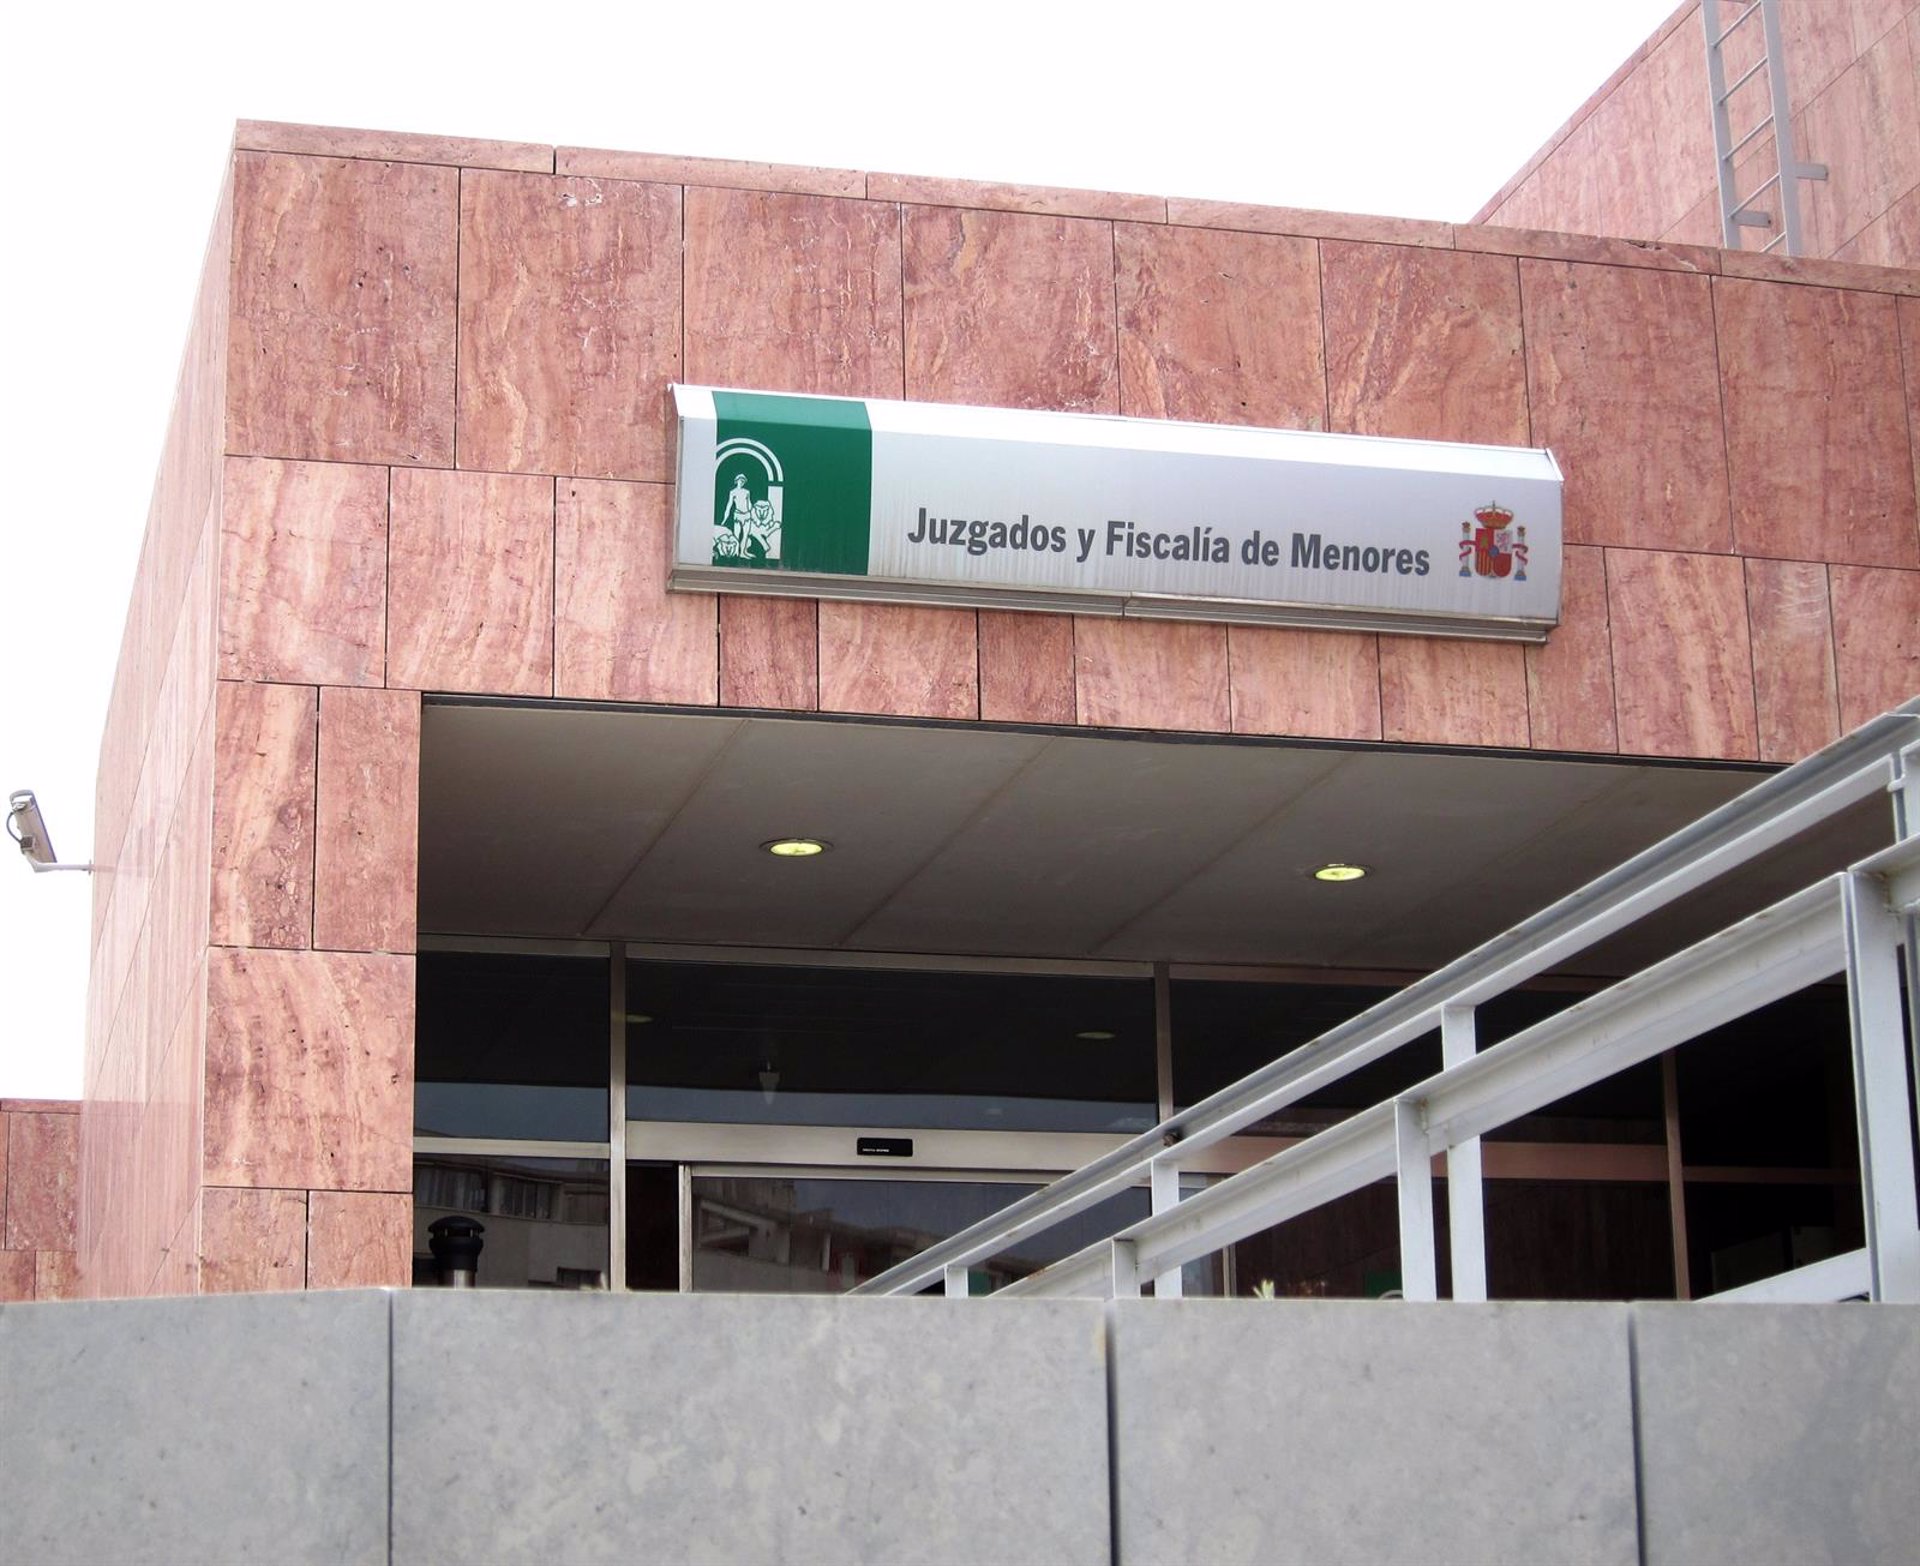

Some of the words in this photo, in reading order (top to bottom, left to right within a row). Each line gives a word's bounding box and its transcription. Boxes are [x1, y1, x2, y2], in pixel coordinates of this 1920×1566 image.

[908, 508, 1068, 557] Juzgados
[1077, 529, 1097, 564] y
[1106, 521, 1231, 565] Fiscalía
[1242, 531, 1281, 568] de
[1291, 533, 1431, 578] Menores
